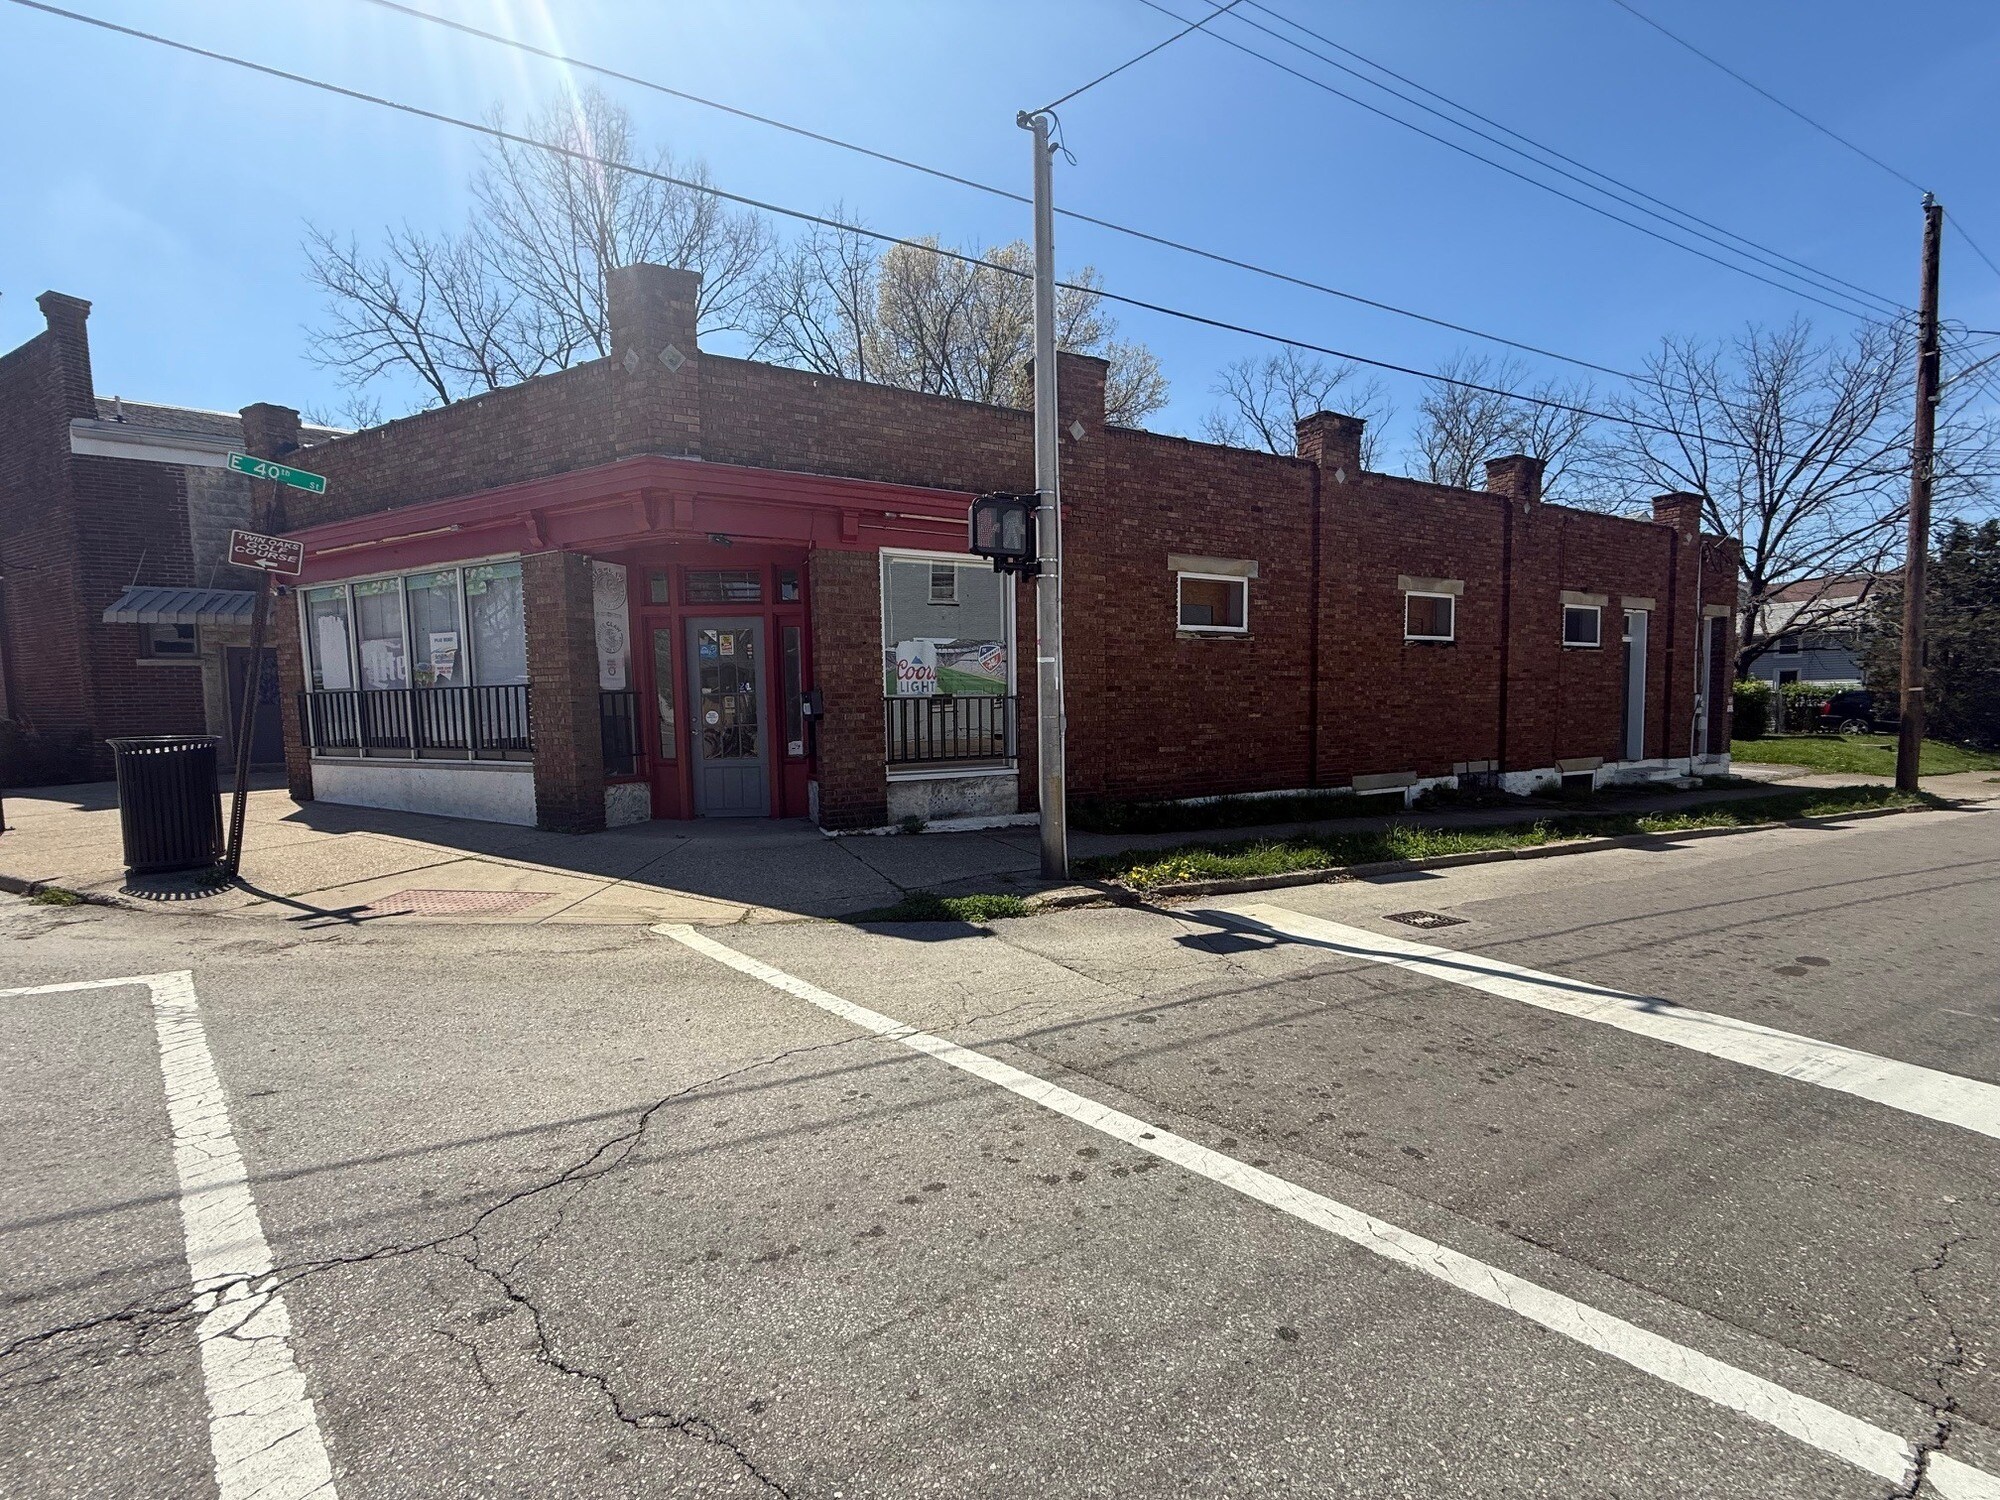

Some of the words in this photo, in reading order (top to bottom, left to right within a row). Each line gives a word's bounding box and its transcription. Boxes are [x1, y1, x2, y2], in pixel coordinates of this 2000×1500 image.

[231, 455, 242, 470] E
[254, 463, 291, 479] 40th
[309, 481, 320, 491] St
[238, 534, 266, 544] TWIN
[268, 540, 300, 551] OAKS
[246, 542, 288, 553] GOLF
[234, 546, 298, 563] COURSE
[900, 681, 935, 693] LIGHT
